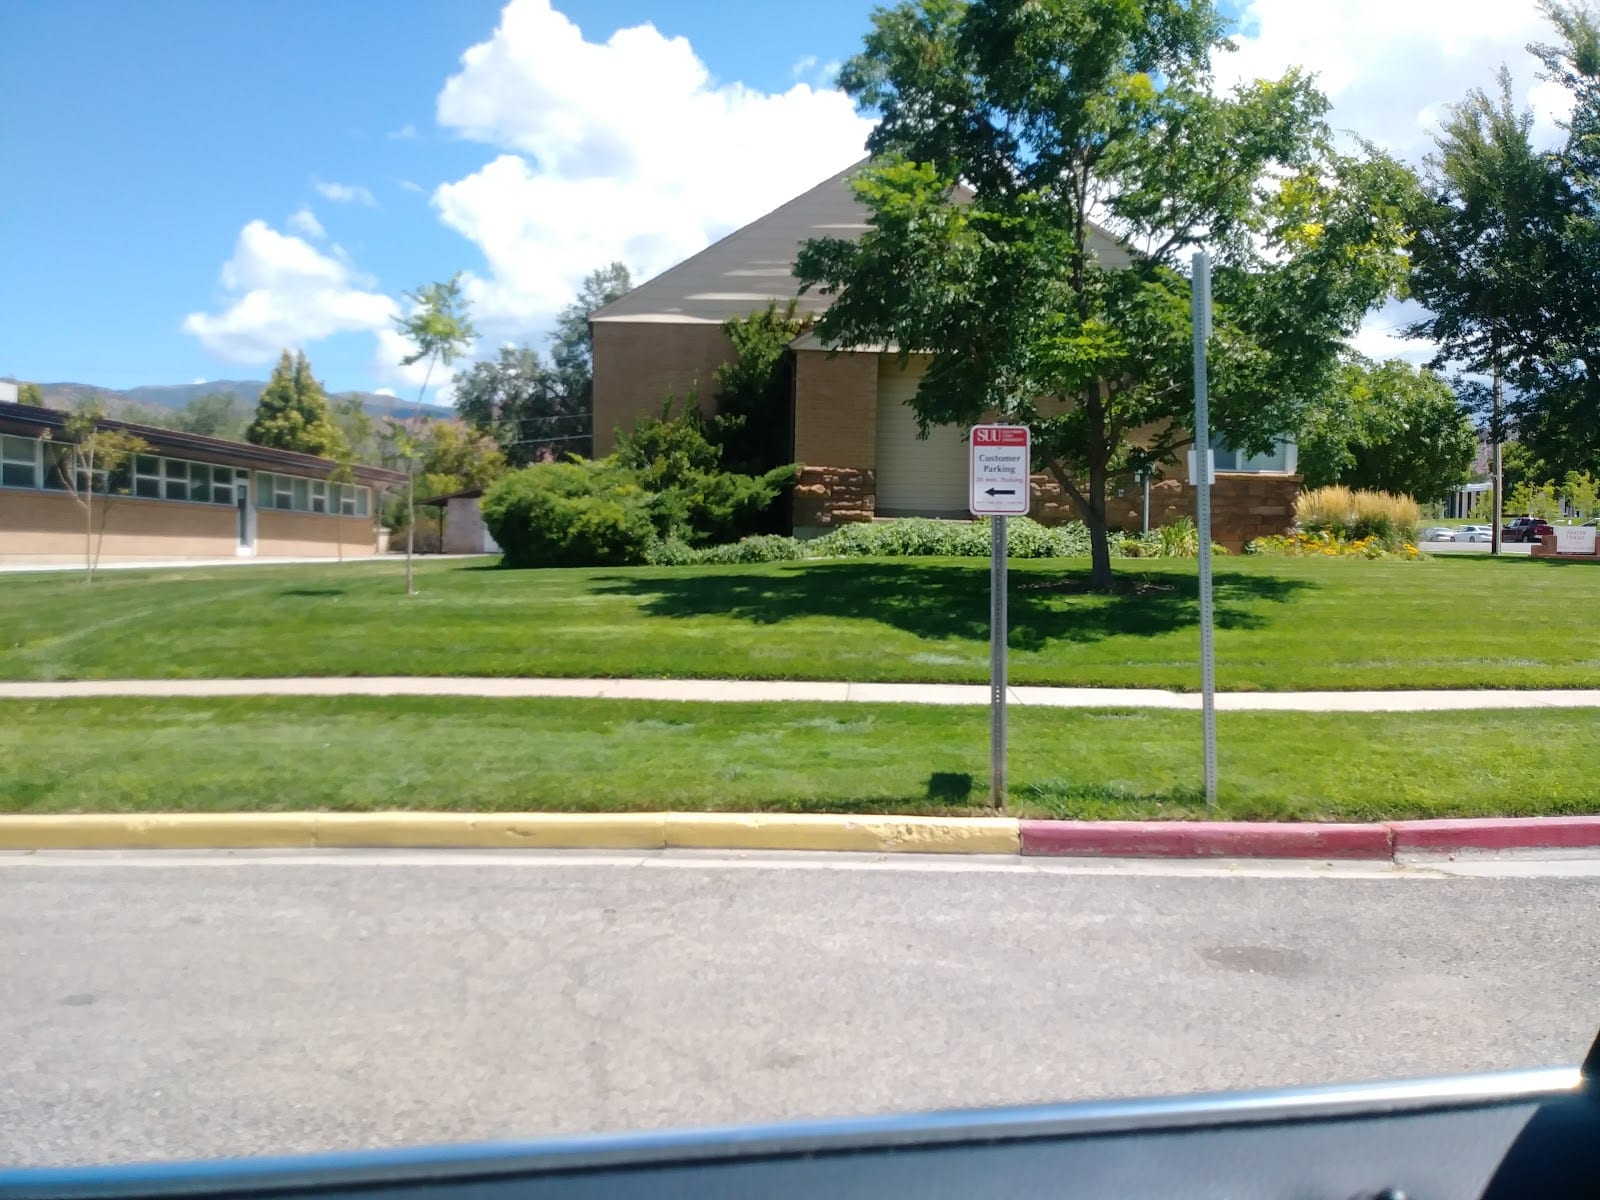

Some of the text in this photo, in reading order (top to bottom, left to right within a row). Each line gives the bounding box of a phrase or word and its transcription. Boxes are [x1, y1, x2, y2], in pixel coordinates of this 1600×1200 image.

[977, 430, 1001, 442] SUU
[979, 454, 1021, 462] Customer
[984, 465, 1015, 475] Parking
